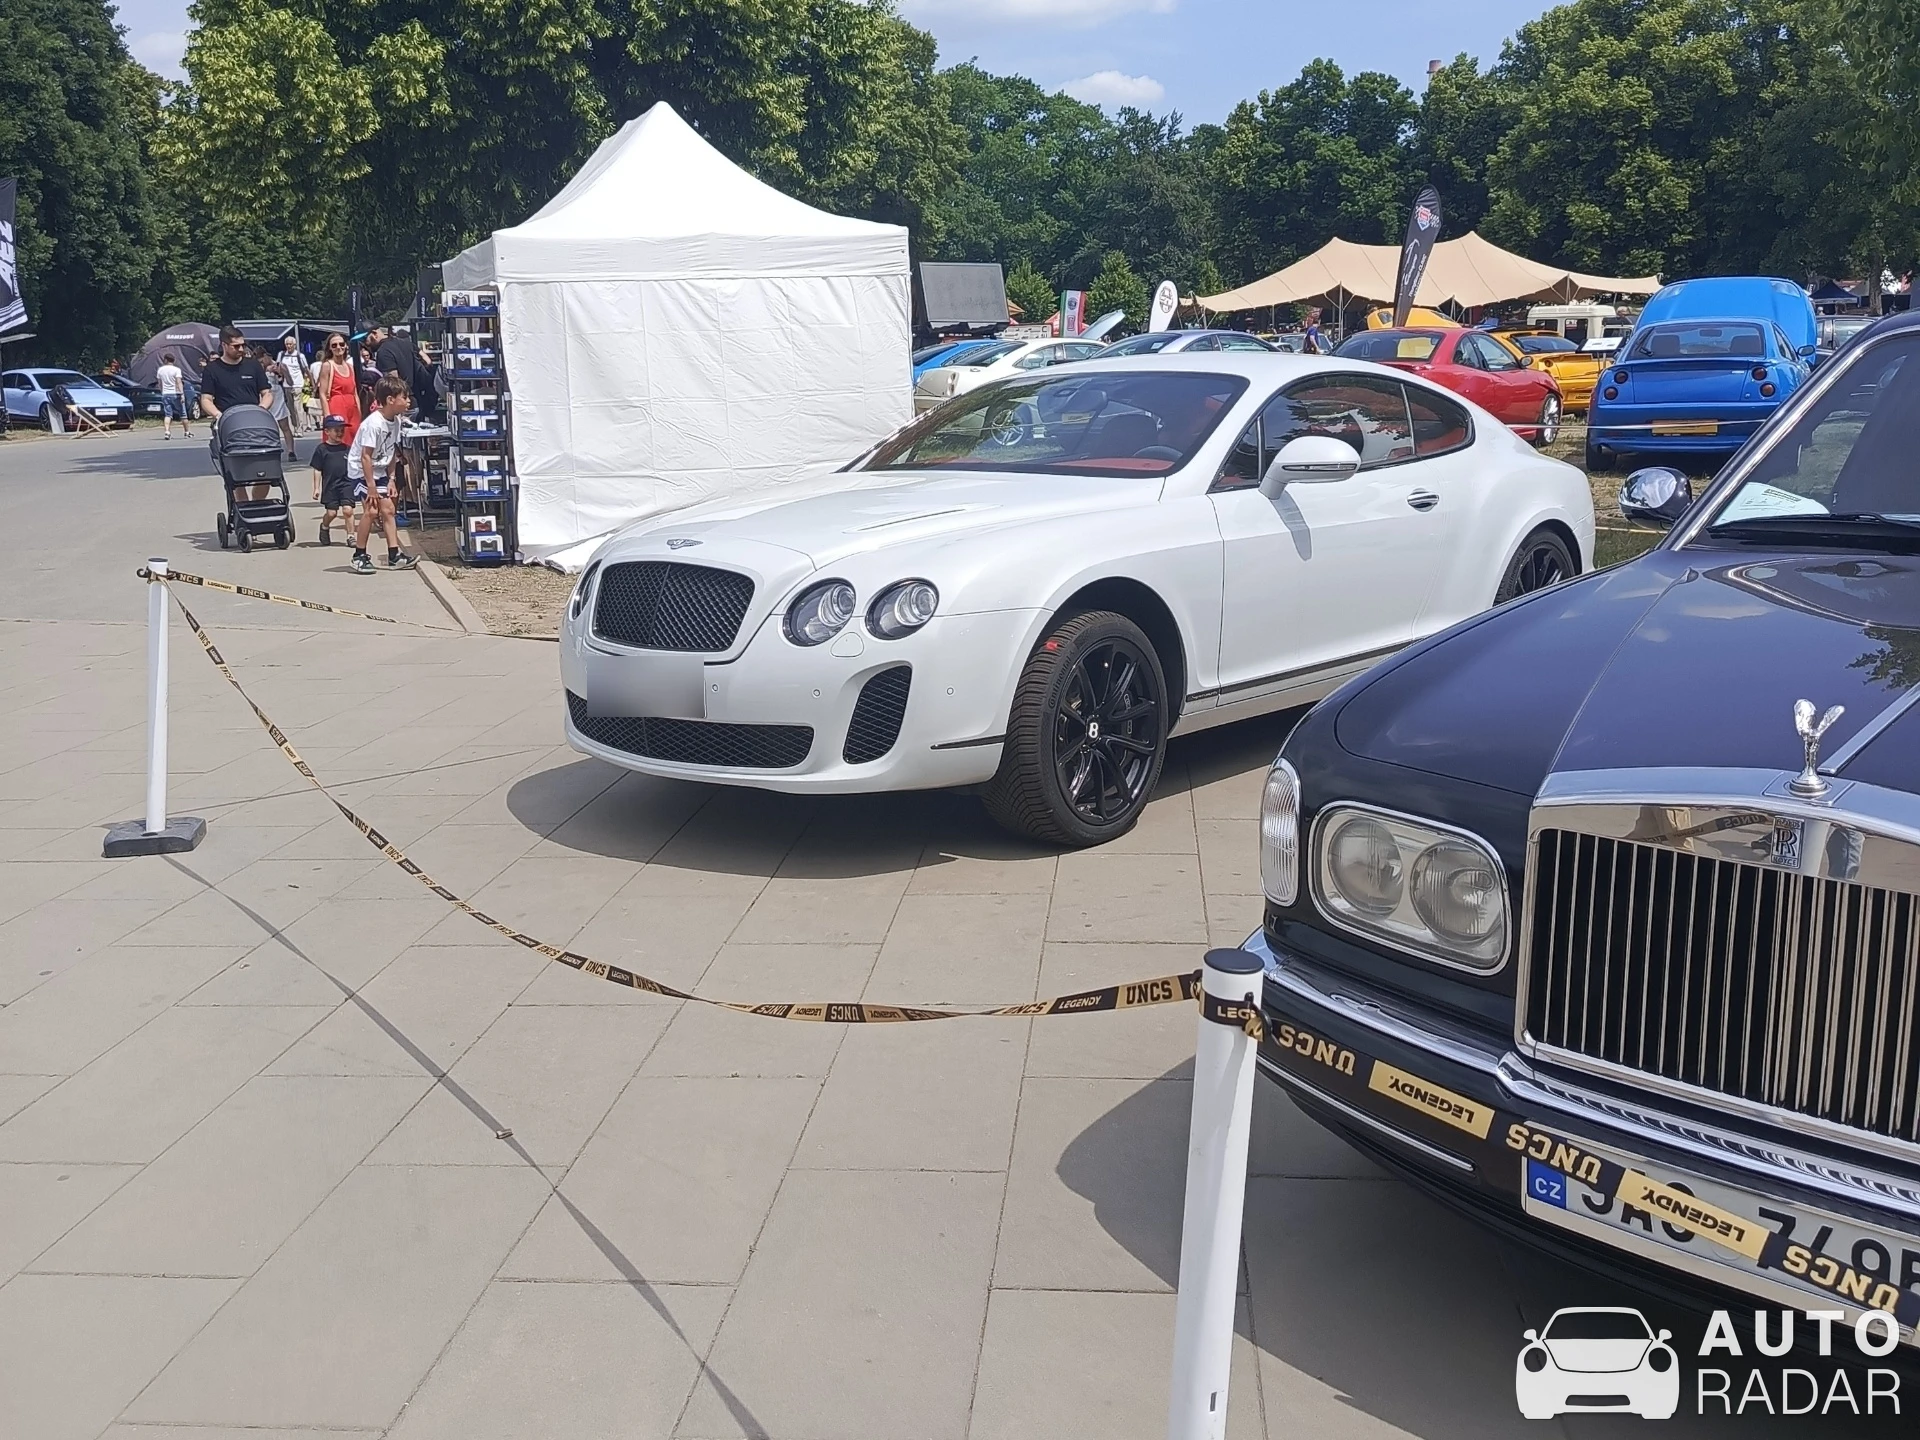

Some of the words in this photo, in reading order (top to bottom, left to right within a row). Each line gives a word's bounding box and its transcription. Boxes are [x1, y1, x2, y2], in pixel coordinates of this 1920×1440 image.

[240, 587, 265, 598] UNCS
[198, 630, 211, 647] UNCS
[1088, 722, 1099, 739] B
[385, 845, 402, 860] UNCS
[537, 945, 561, 958] UNCS
[585, 960, 607, 976] UNCS
[635, 976, 658, 992] UNCS
[1005, 1001, 1048, 1014] UNCS
[1058, 995, 1102, 1009] LEGENDY
[1126, 979, 1173, 1005] UNCS
[757, 1004, 788, 1016] UNCS
[831, 1005, 860, 1021] UNCS
[1279, 1024, 1356, 1076] UNCS
[1506, 1123, 1602, 1184] UNCS
[1782, 1245, 1899, 1315] UNCS
[1535, 1177, 1561, 1199] CZ
